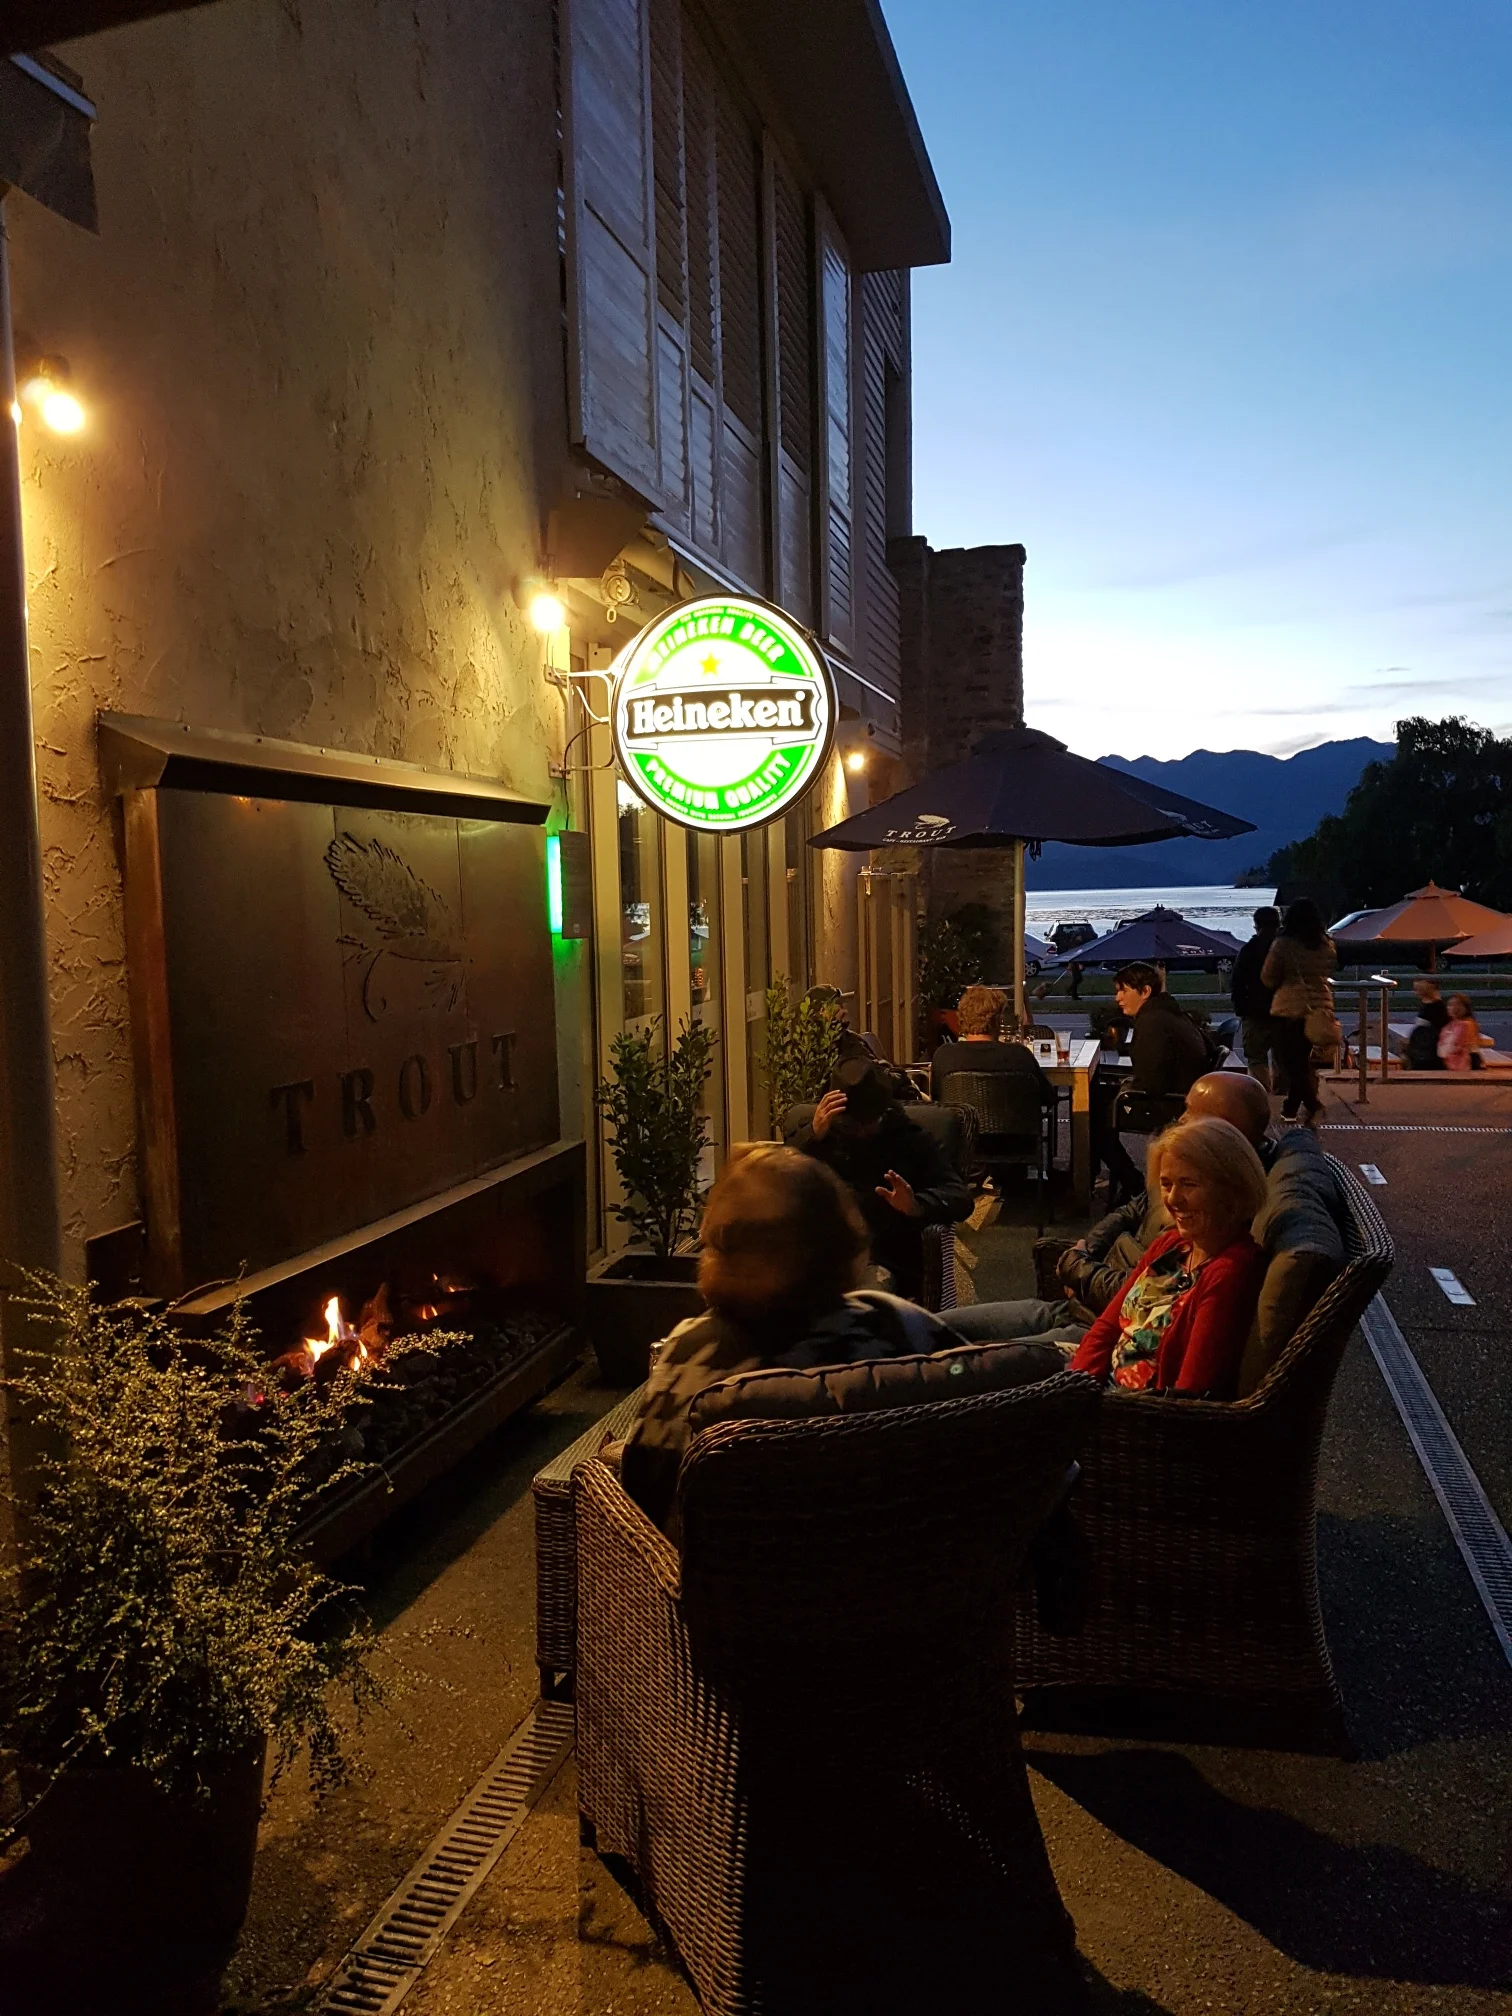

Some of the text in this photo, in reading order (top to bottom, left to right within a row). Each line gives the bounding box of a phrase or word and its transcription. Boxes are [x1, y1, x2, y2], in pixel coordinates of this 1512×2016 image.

[738, 622, 786, 664] BEER
[633, 692, 804, 735] Heineken
[645, 759, 720, 810] PREMIUM
[724, 751, 792, 809] QUALITY
[885, 825, 957, 838] TROUT
[270, 1031, 519, 1158] TROUT
